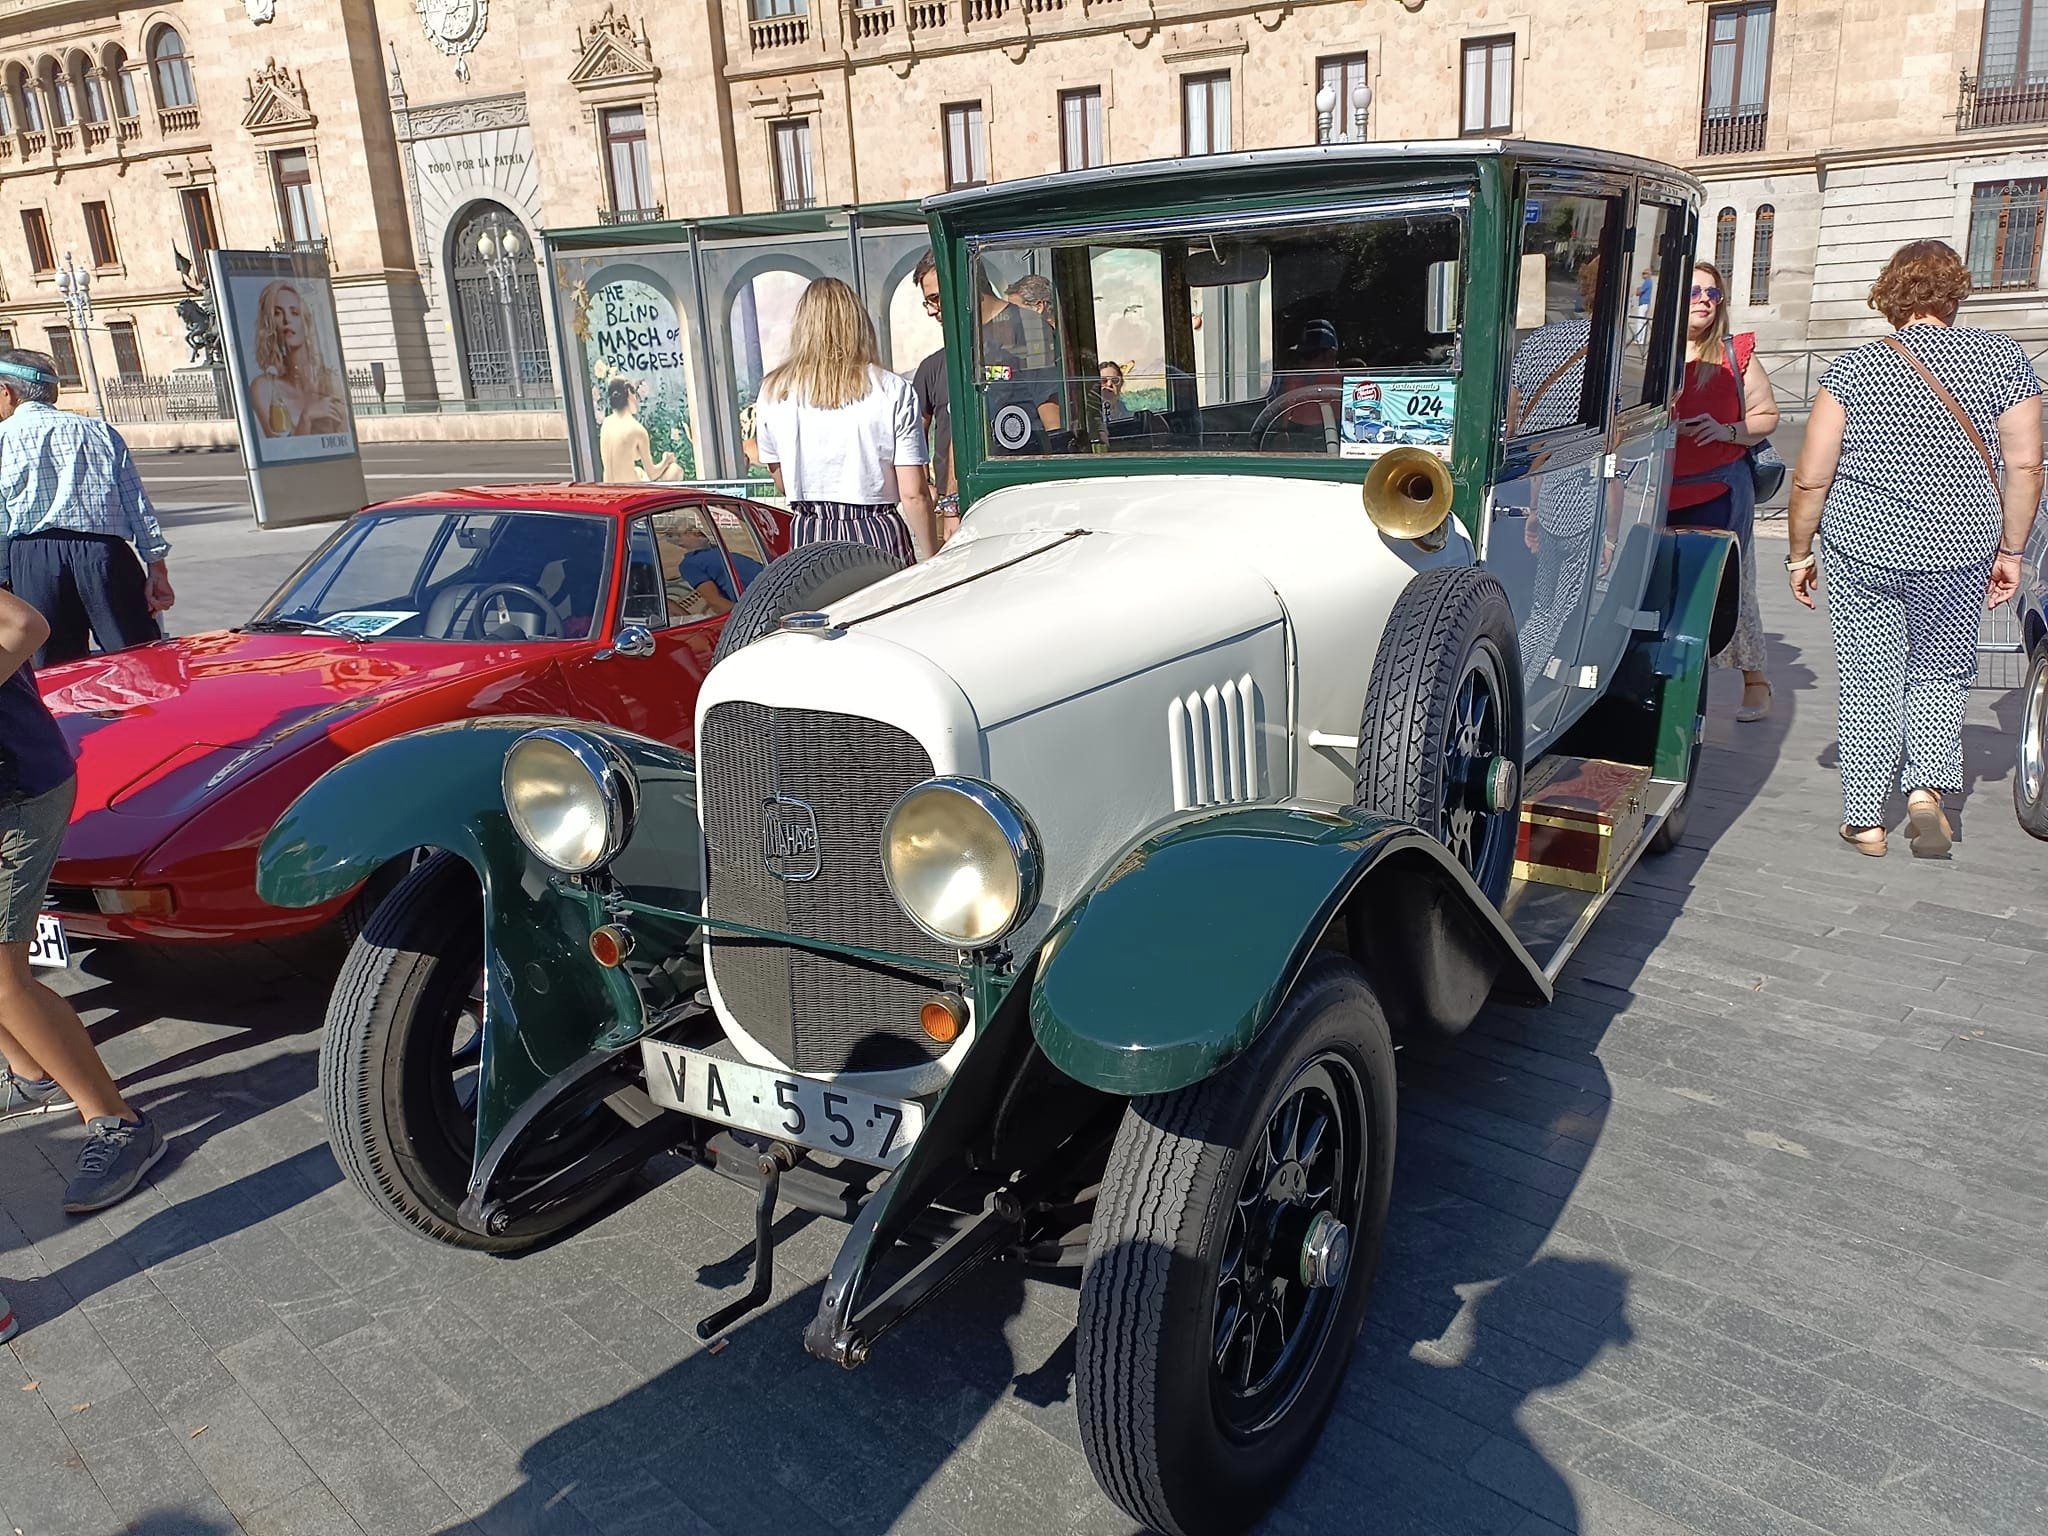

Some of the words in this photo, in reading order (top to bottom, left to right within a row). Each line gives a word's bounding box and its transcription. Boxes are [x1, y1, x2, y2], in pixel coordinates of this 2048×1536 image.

[428, 162, 451, 175] TODO
[457, 159, 475, 171] POR
[478, 157, 490, 169] LA
[494, 152, 525, 167] PATRIA
[599, 285, 625, 302] THE
[598, 326, 661, 356] MARCH
[666, 327, 680, 341] OF
[1406, 395, 1443, 418] 024
[320, 435, 348, 449] DIOR
